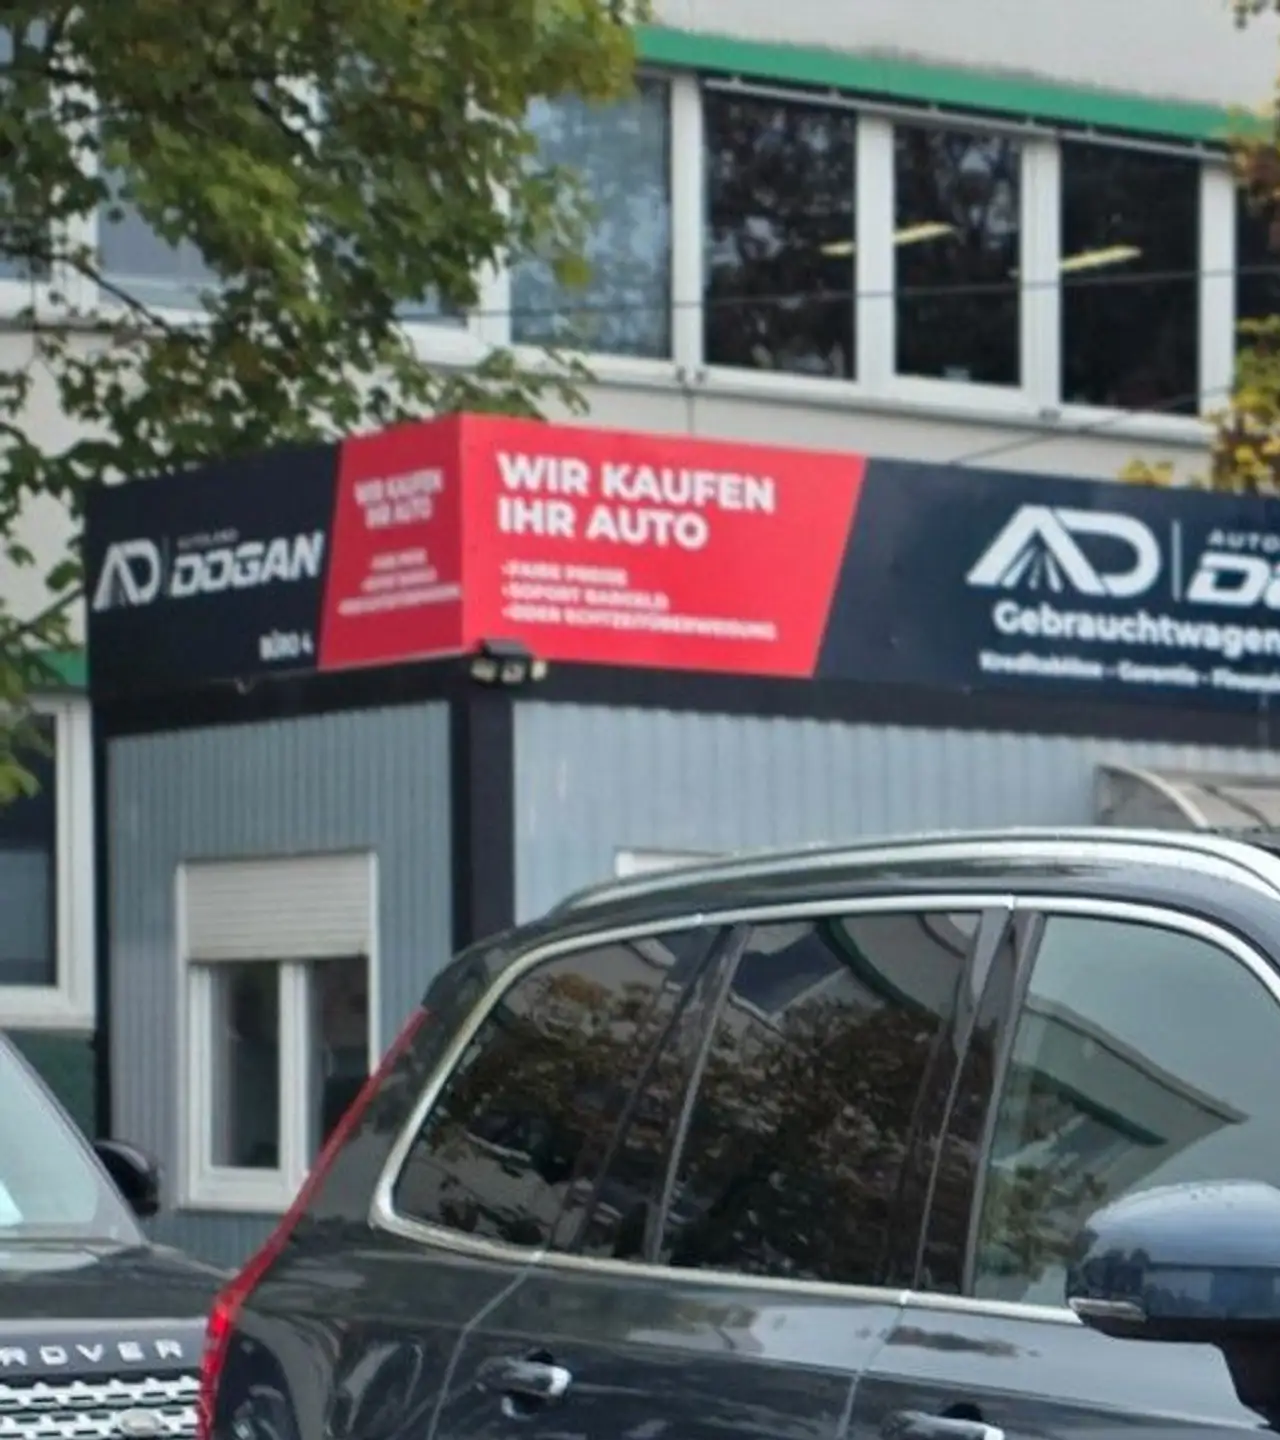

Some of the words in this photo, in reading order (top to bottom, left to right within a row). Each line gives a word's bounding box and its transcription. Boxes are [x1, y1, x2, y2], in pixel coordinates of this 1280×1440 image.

[497, 451, 589, 497] WIR
[602, 462, 777, 515] KAUFEN
[497, 496, 575, 539] IHR
[586, 504, 709, 550] AUTO
[171, 530, 325, 598] DOGAN
[0, 1338, 183, 1366] ROVER
